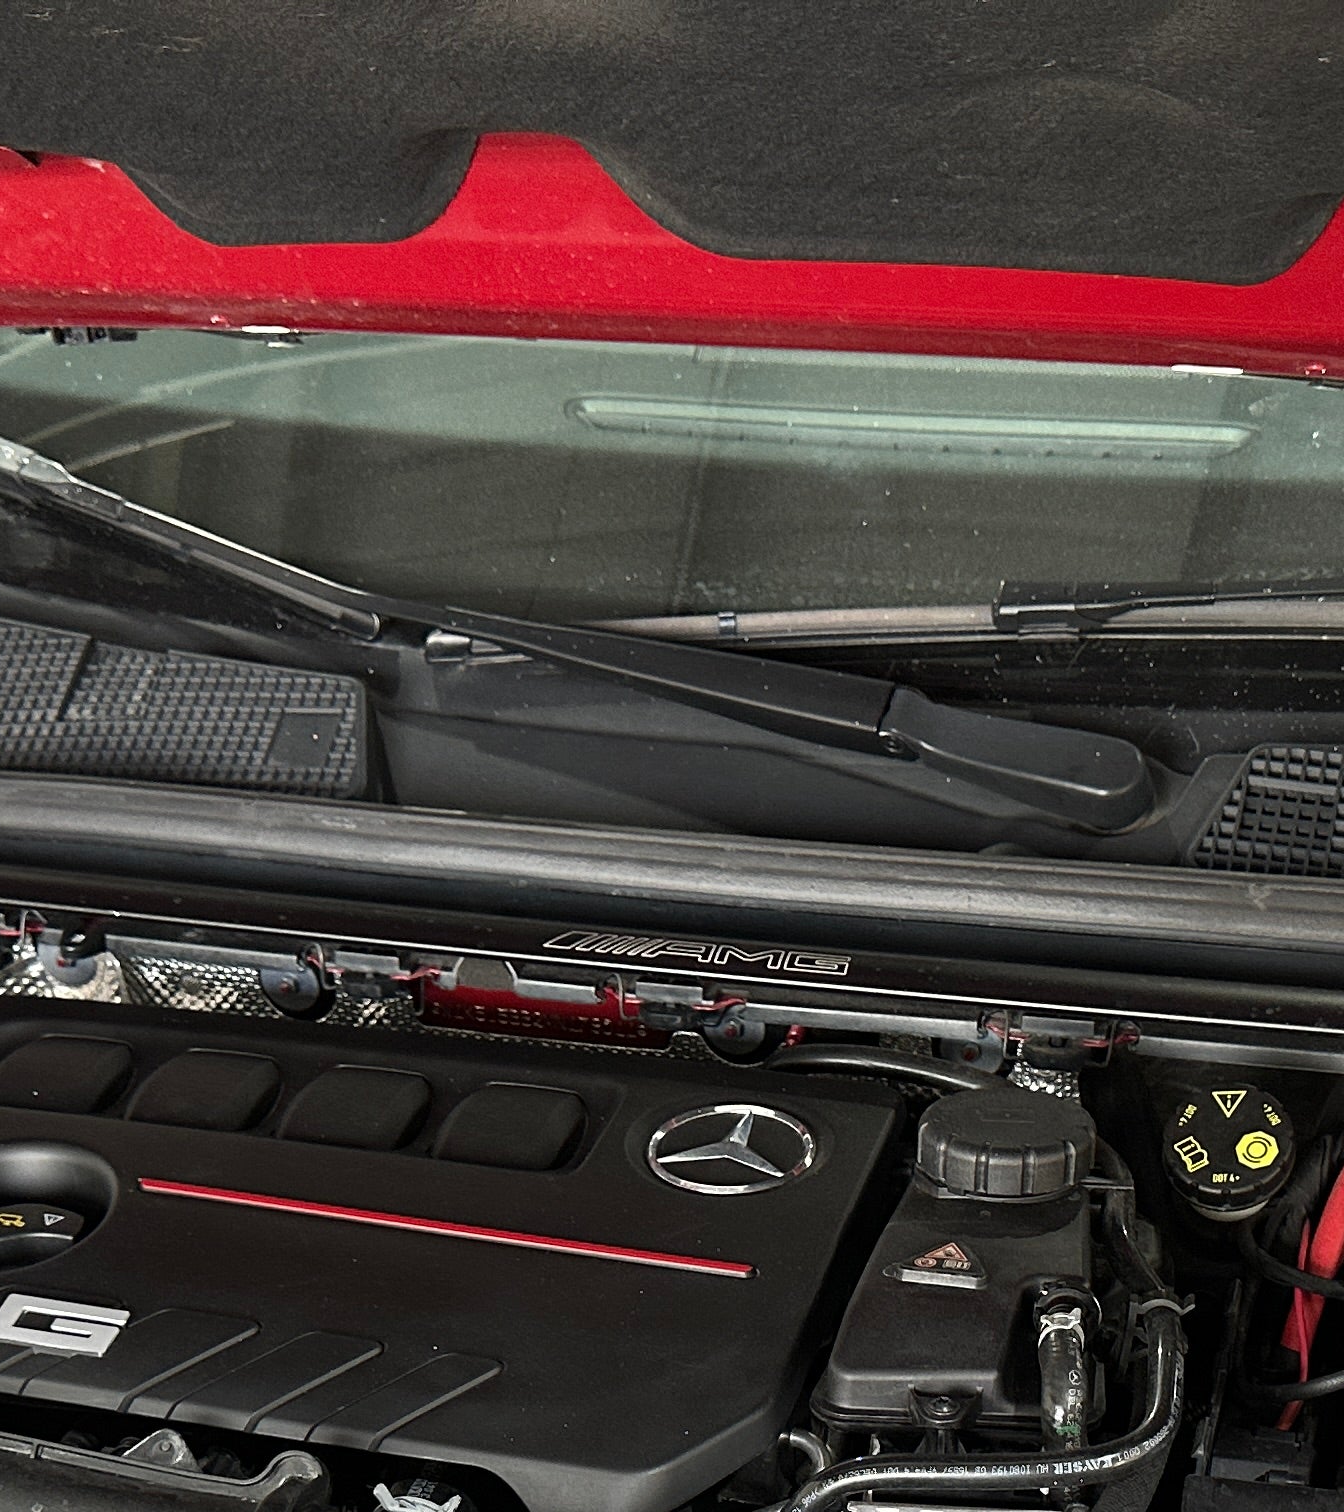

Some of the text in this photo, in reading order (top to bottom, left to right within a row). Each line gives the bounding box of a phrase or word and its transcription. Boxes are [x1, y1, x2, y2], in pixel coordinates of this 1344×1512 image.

[644, 937, 852, 976] AMG
[1212, 1173, 1228, 1183] DOT
[1053, 1454, 1114, 1475] KAYSER
